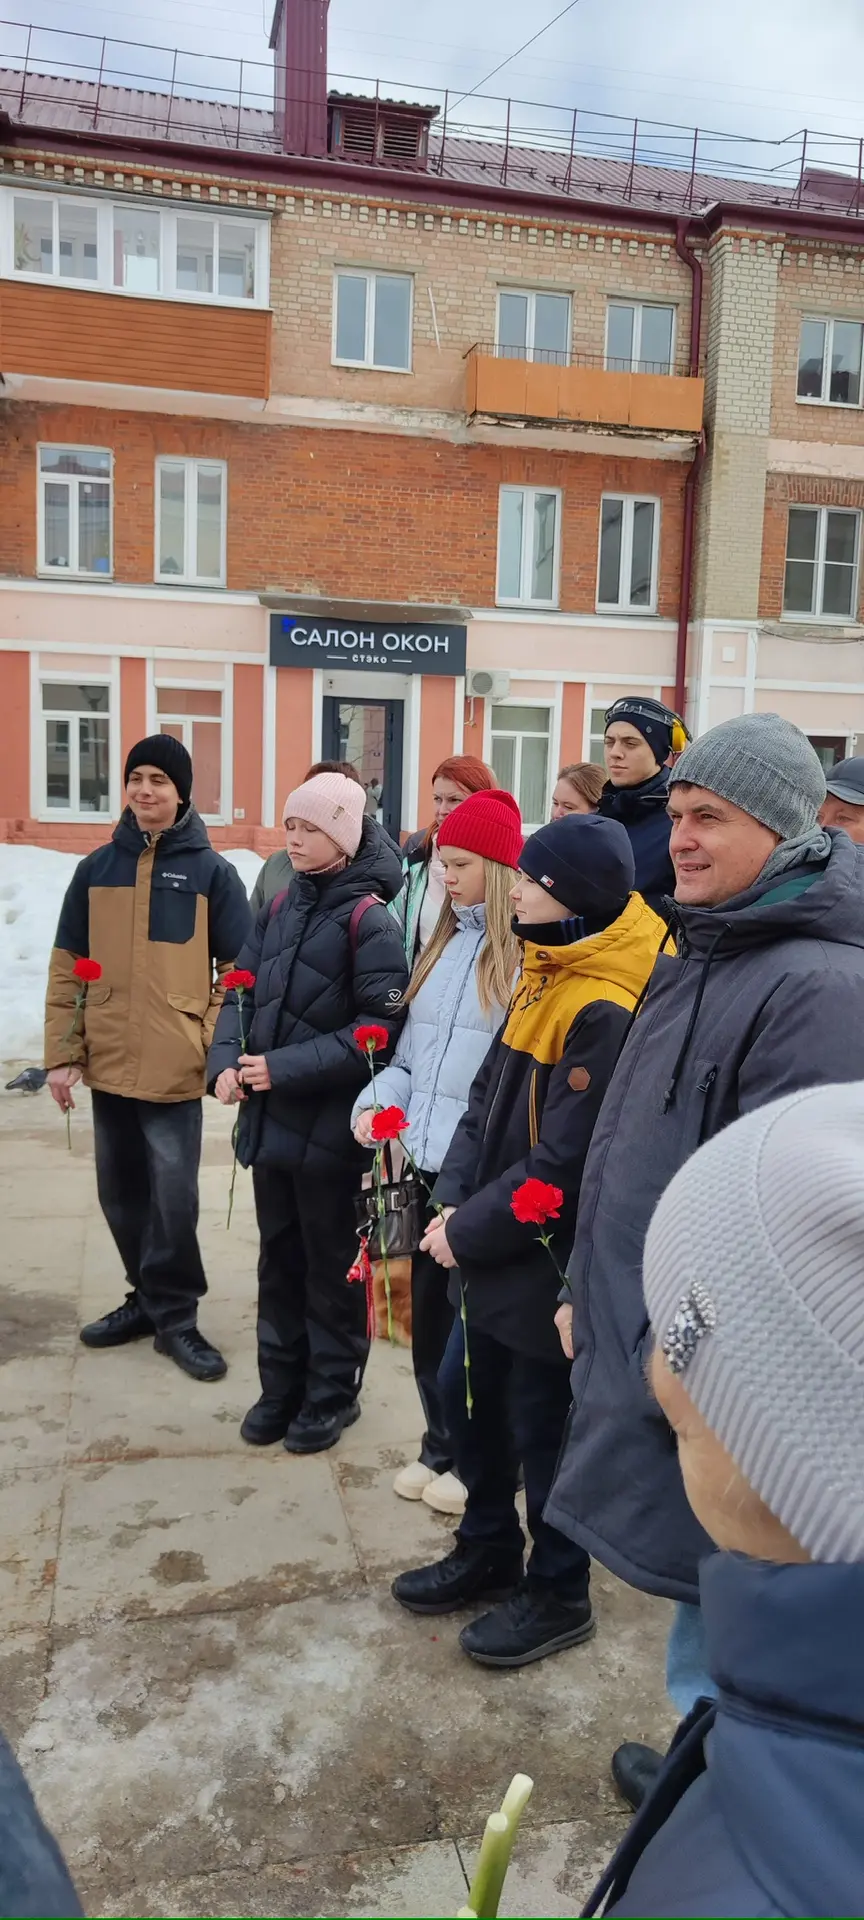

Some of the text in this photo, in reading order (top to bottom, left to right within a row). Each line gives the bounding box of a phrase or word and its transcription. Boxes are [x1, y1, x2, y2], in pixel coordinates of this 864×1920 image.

[290, 627, 449, 653] САЛОН ОКОН
[352, 654, 388, 664] СТЭКО
